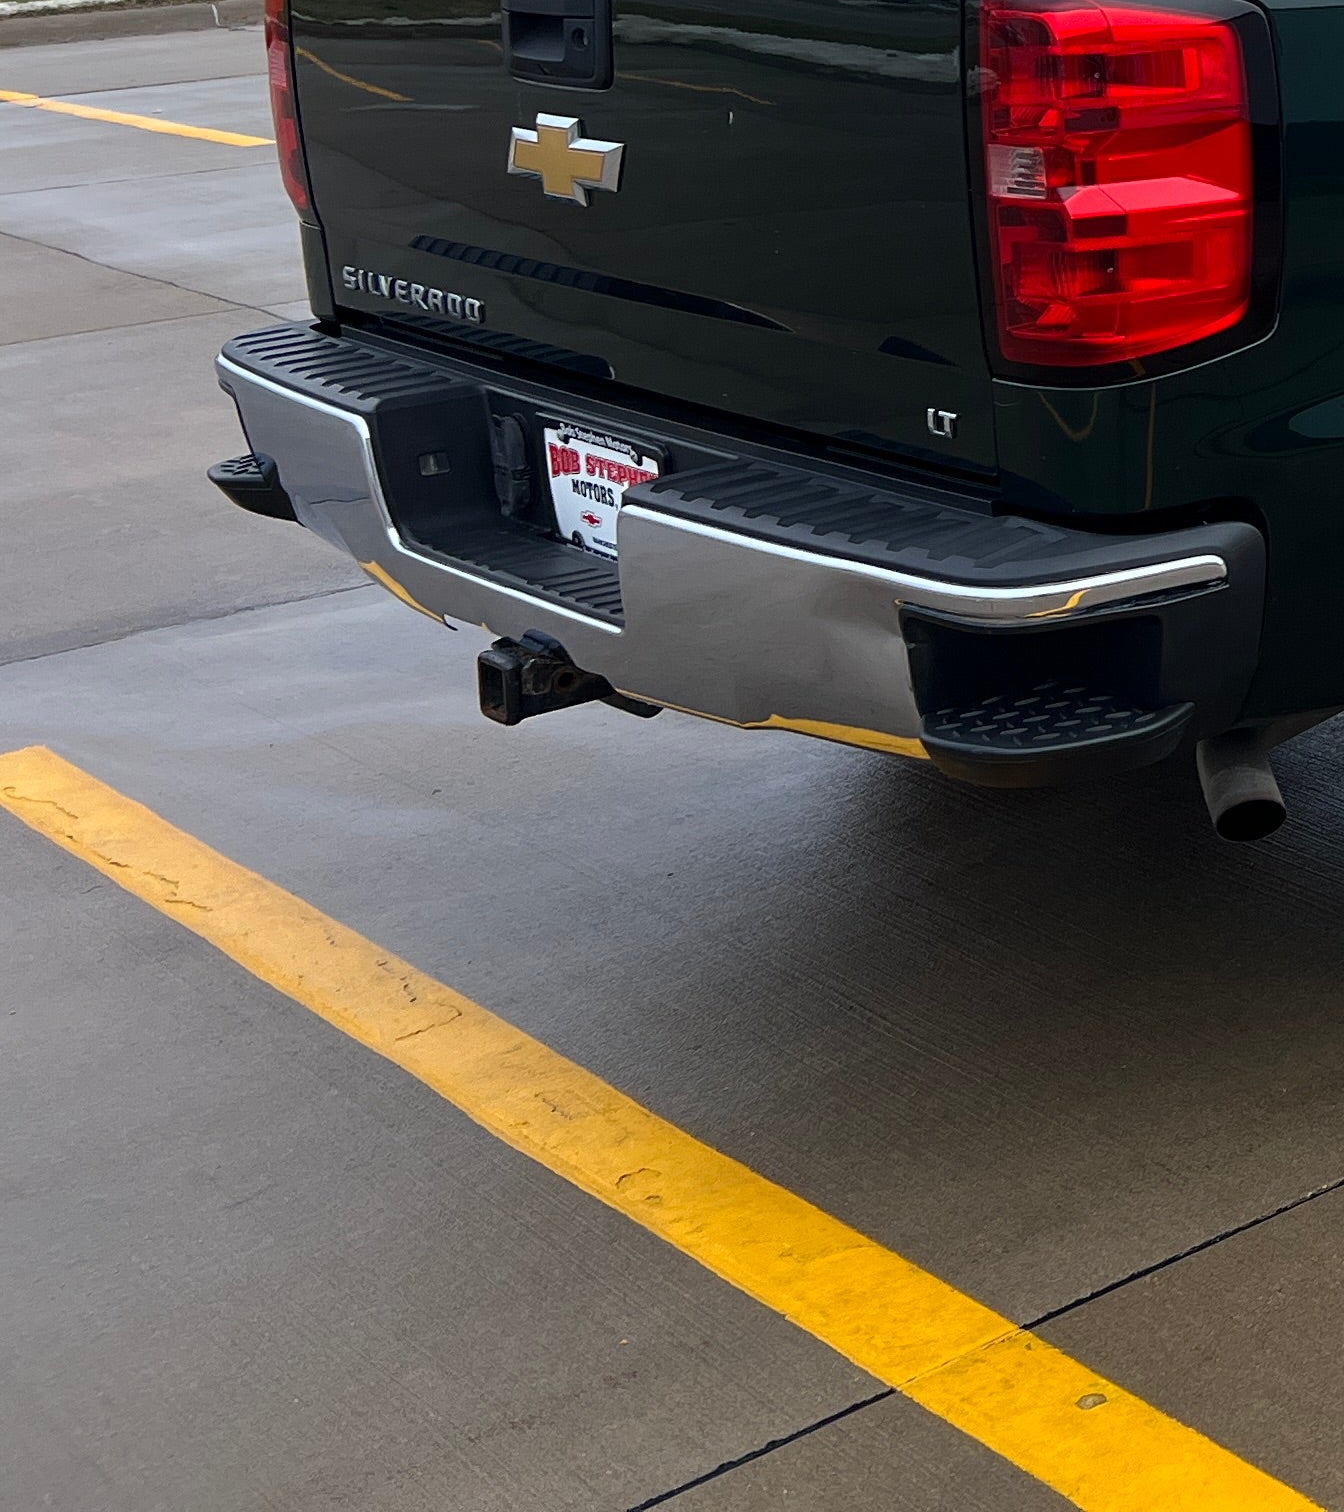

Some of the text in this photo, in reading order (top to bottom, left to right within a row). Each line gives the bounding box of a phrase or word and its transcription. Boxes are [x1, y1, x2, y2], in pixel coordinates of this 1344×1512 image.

[342, 265, 484, 324] SILVERADO
[927, 407, 957, 439] LT
[548, 441, 581, 478] BOB
